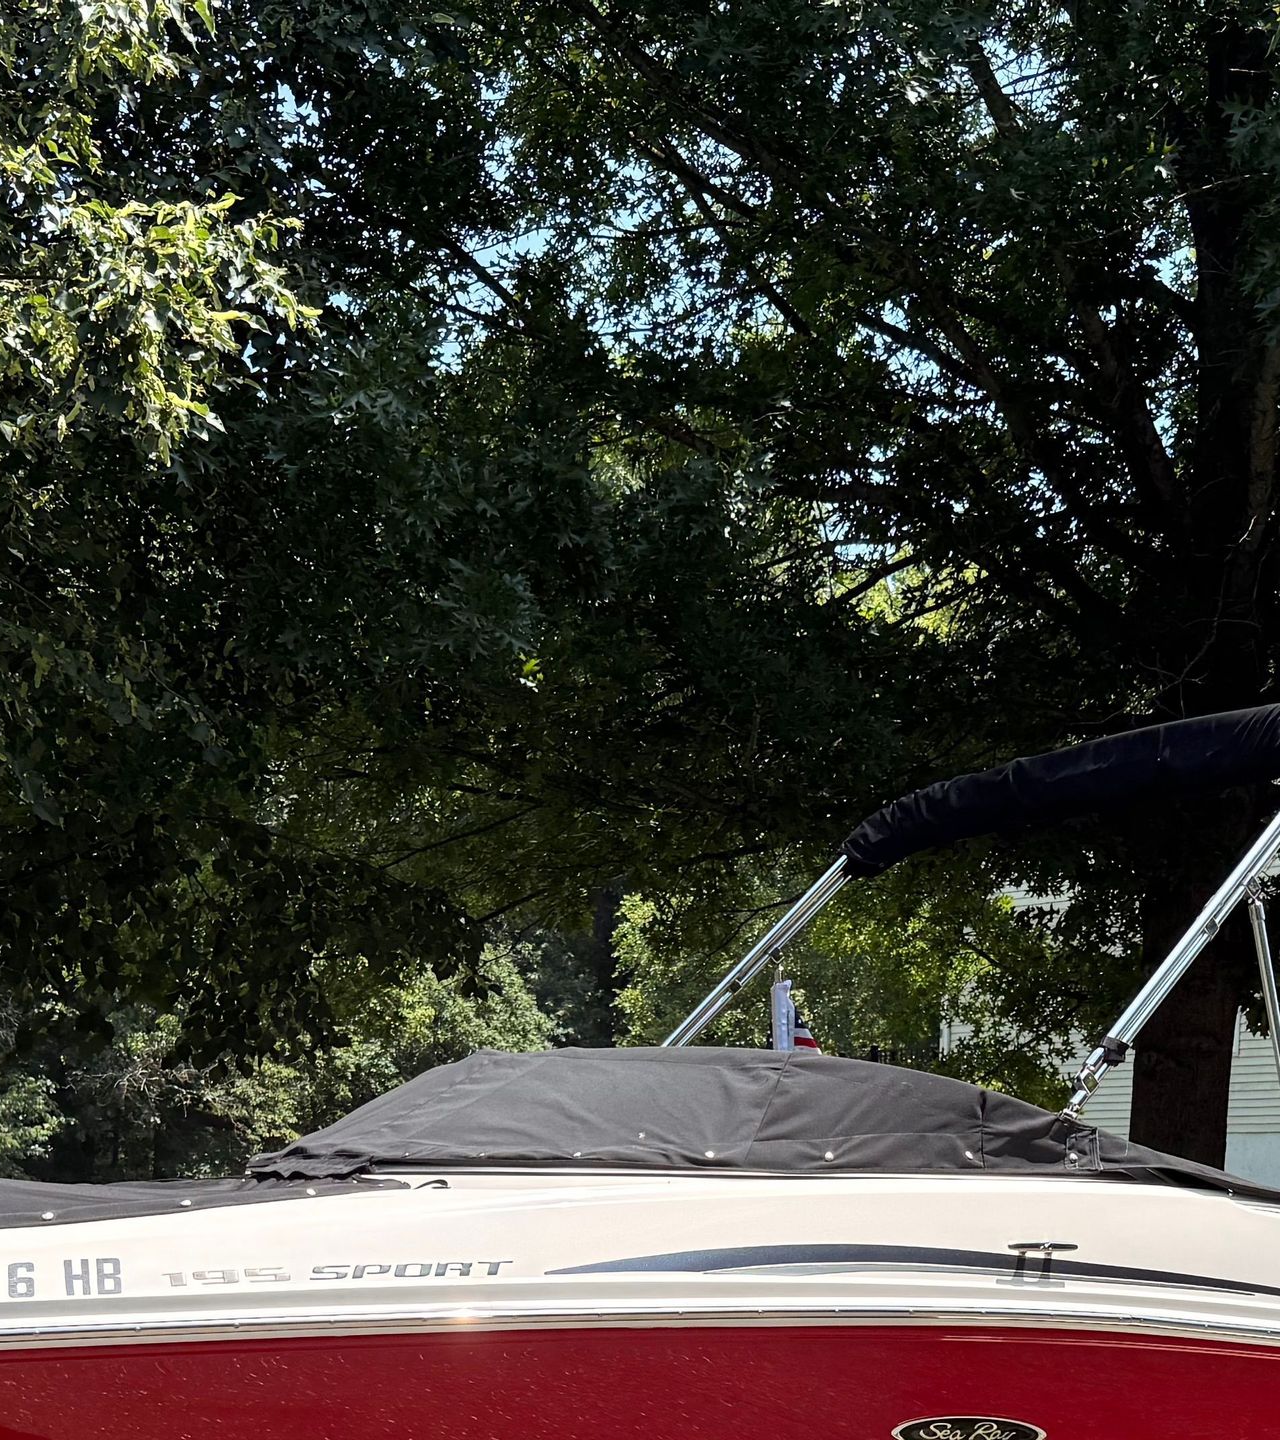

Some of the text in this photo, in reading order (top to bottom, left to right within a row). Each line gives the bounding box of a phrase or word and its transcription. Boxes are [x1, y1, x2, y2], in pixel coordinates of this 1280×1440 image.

[64, 1258, 122, 1296] HB
[162, 1260, 514, 1287] 195 SPORT
[920, 1422, 966, 1440] Sea
